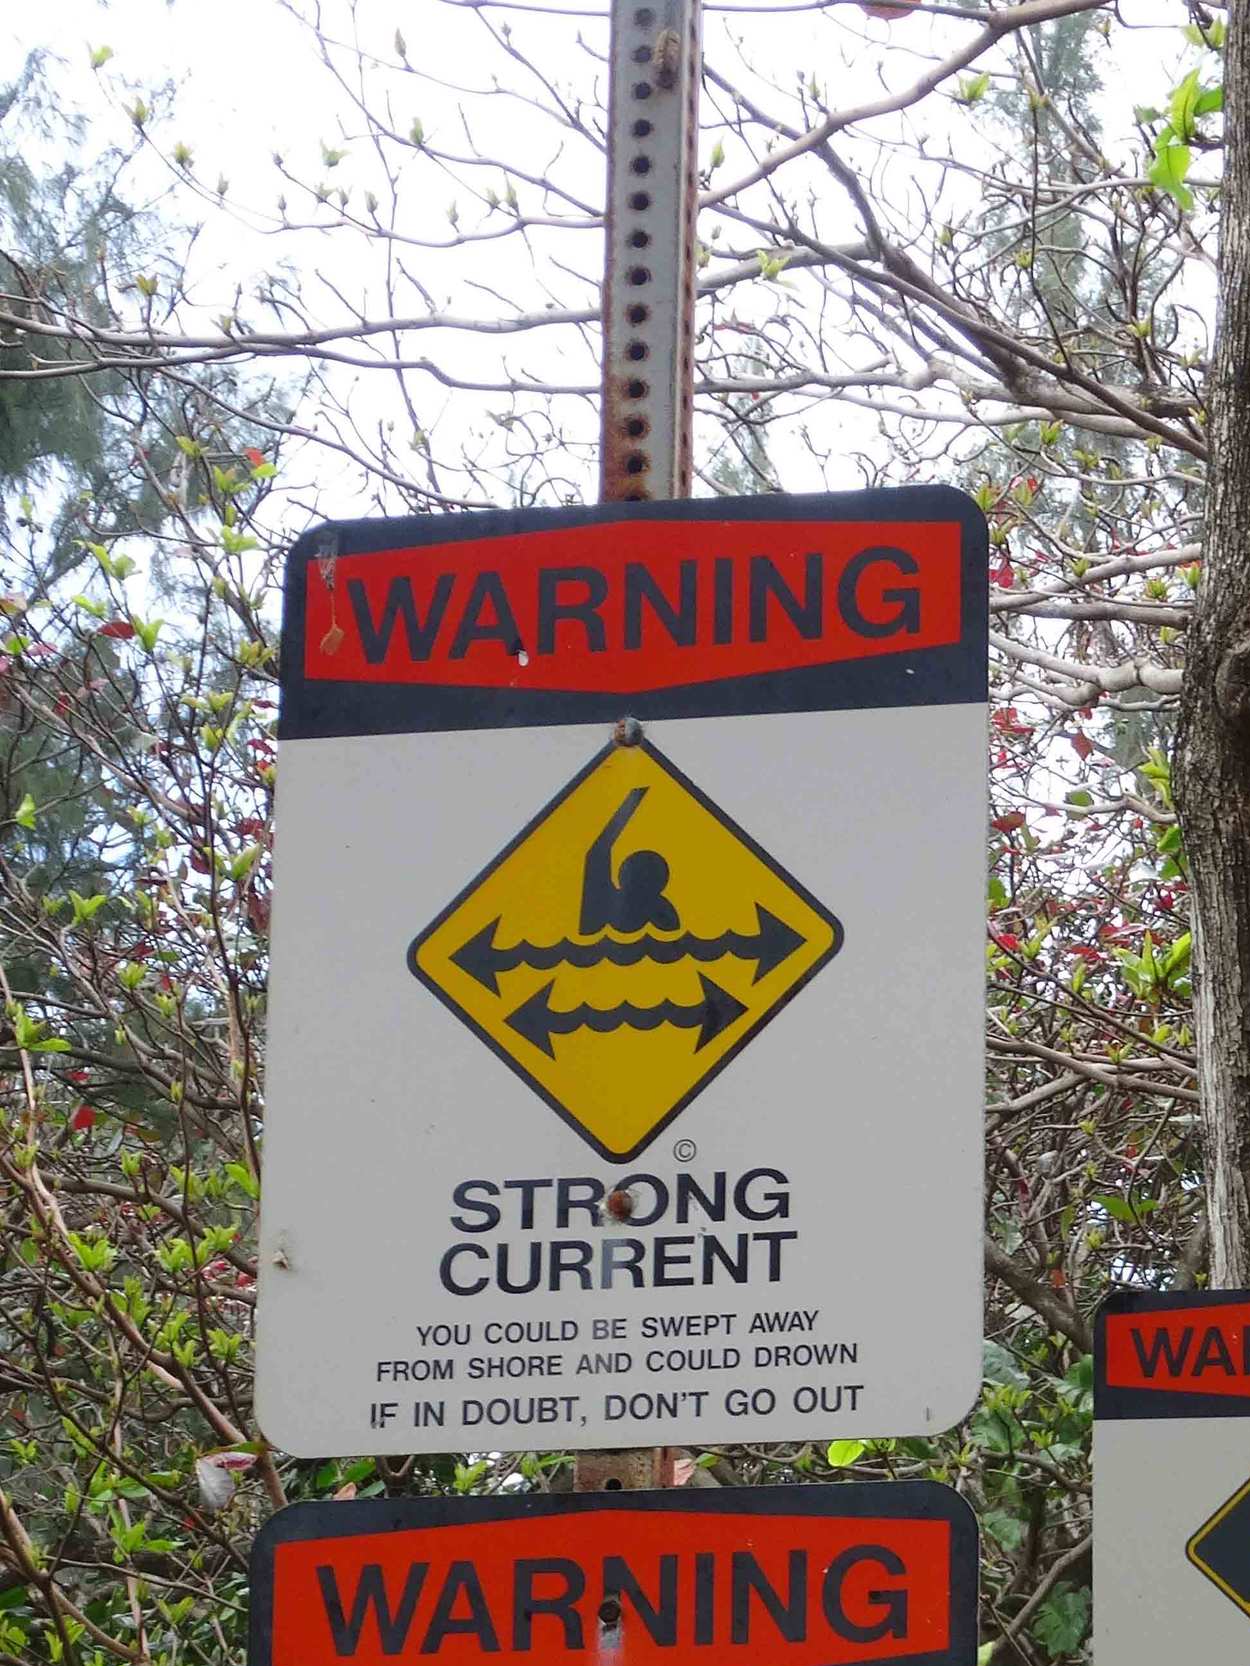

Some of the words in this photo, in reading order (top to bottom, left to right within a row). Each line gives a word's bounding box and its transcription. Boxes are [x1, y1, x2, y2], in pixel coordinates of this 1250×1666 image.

[346, 545, 921, 665] WARNING
[449, 1168, 790, 1233] STRONG
[439, 1230, 798, 1296] CURRENT
[417, 1325, 470, 1346] YOU
[484, 1321, 578, 1343] COULD
[592, 1319, 626, 1340] BE
[641, 1314, 736, 1337] SWEPT
[749, 1310, 819, 1333] AWAY
[376, 1360, 453, 1381] FROM
[468, 1356, 562, 1379] SHORE
[576, 1353, 631, 1375] AND
[646, 1348, 739, 1372] COULD
[754, 1343, 857, 1367] DROWN
[370, 1403, 398, 1428] IF
[414, 1401, 444, 1427] IN
[462, 1396, 587, 1427] DOUBT,
[604, 1392, 708, 1421] DON'T
[724, 1388, 775, 1416] GO
[793, 1385, 864, 1413] OUT
[315, 1543, 910, 1659] WARNING
